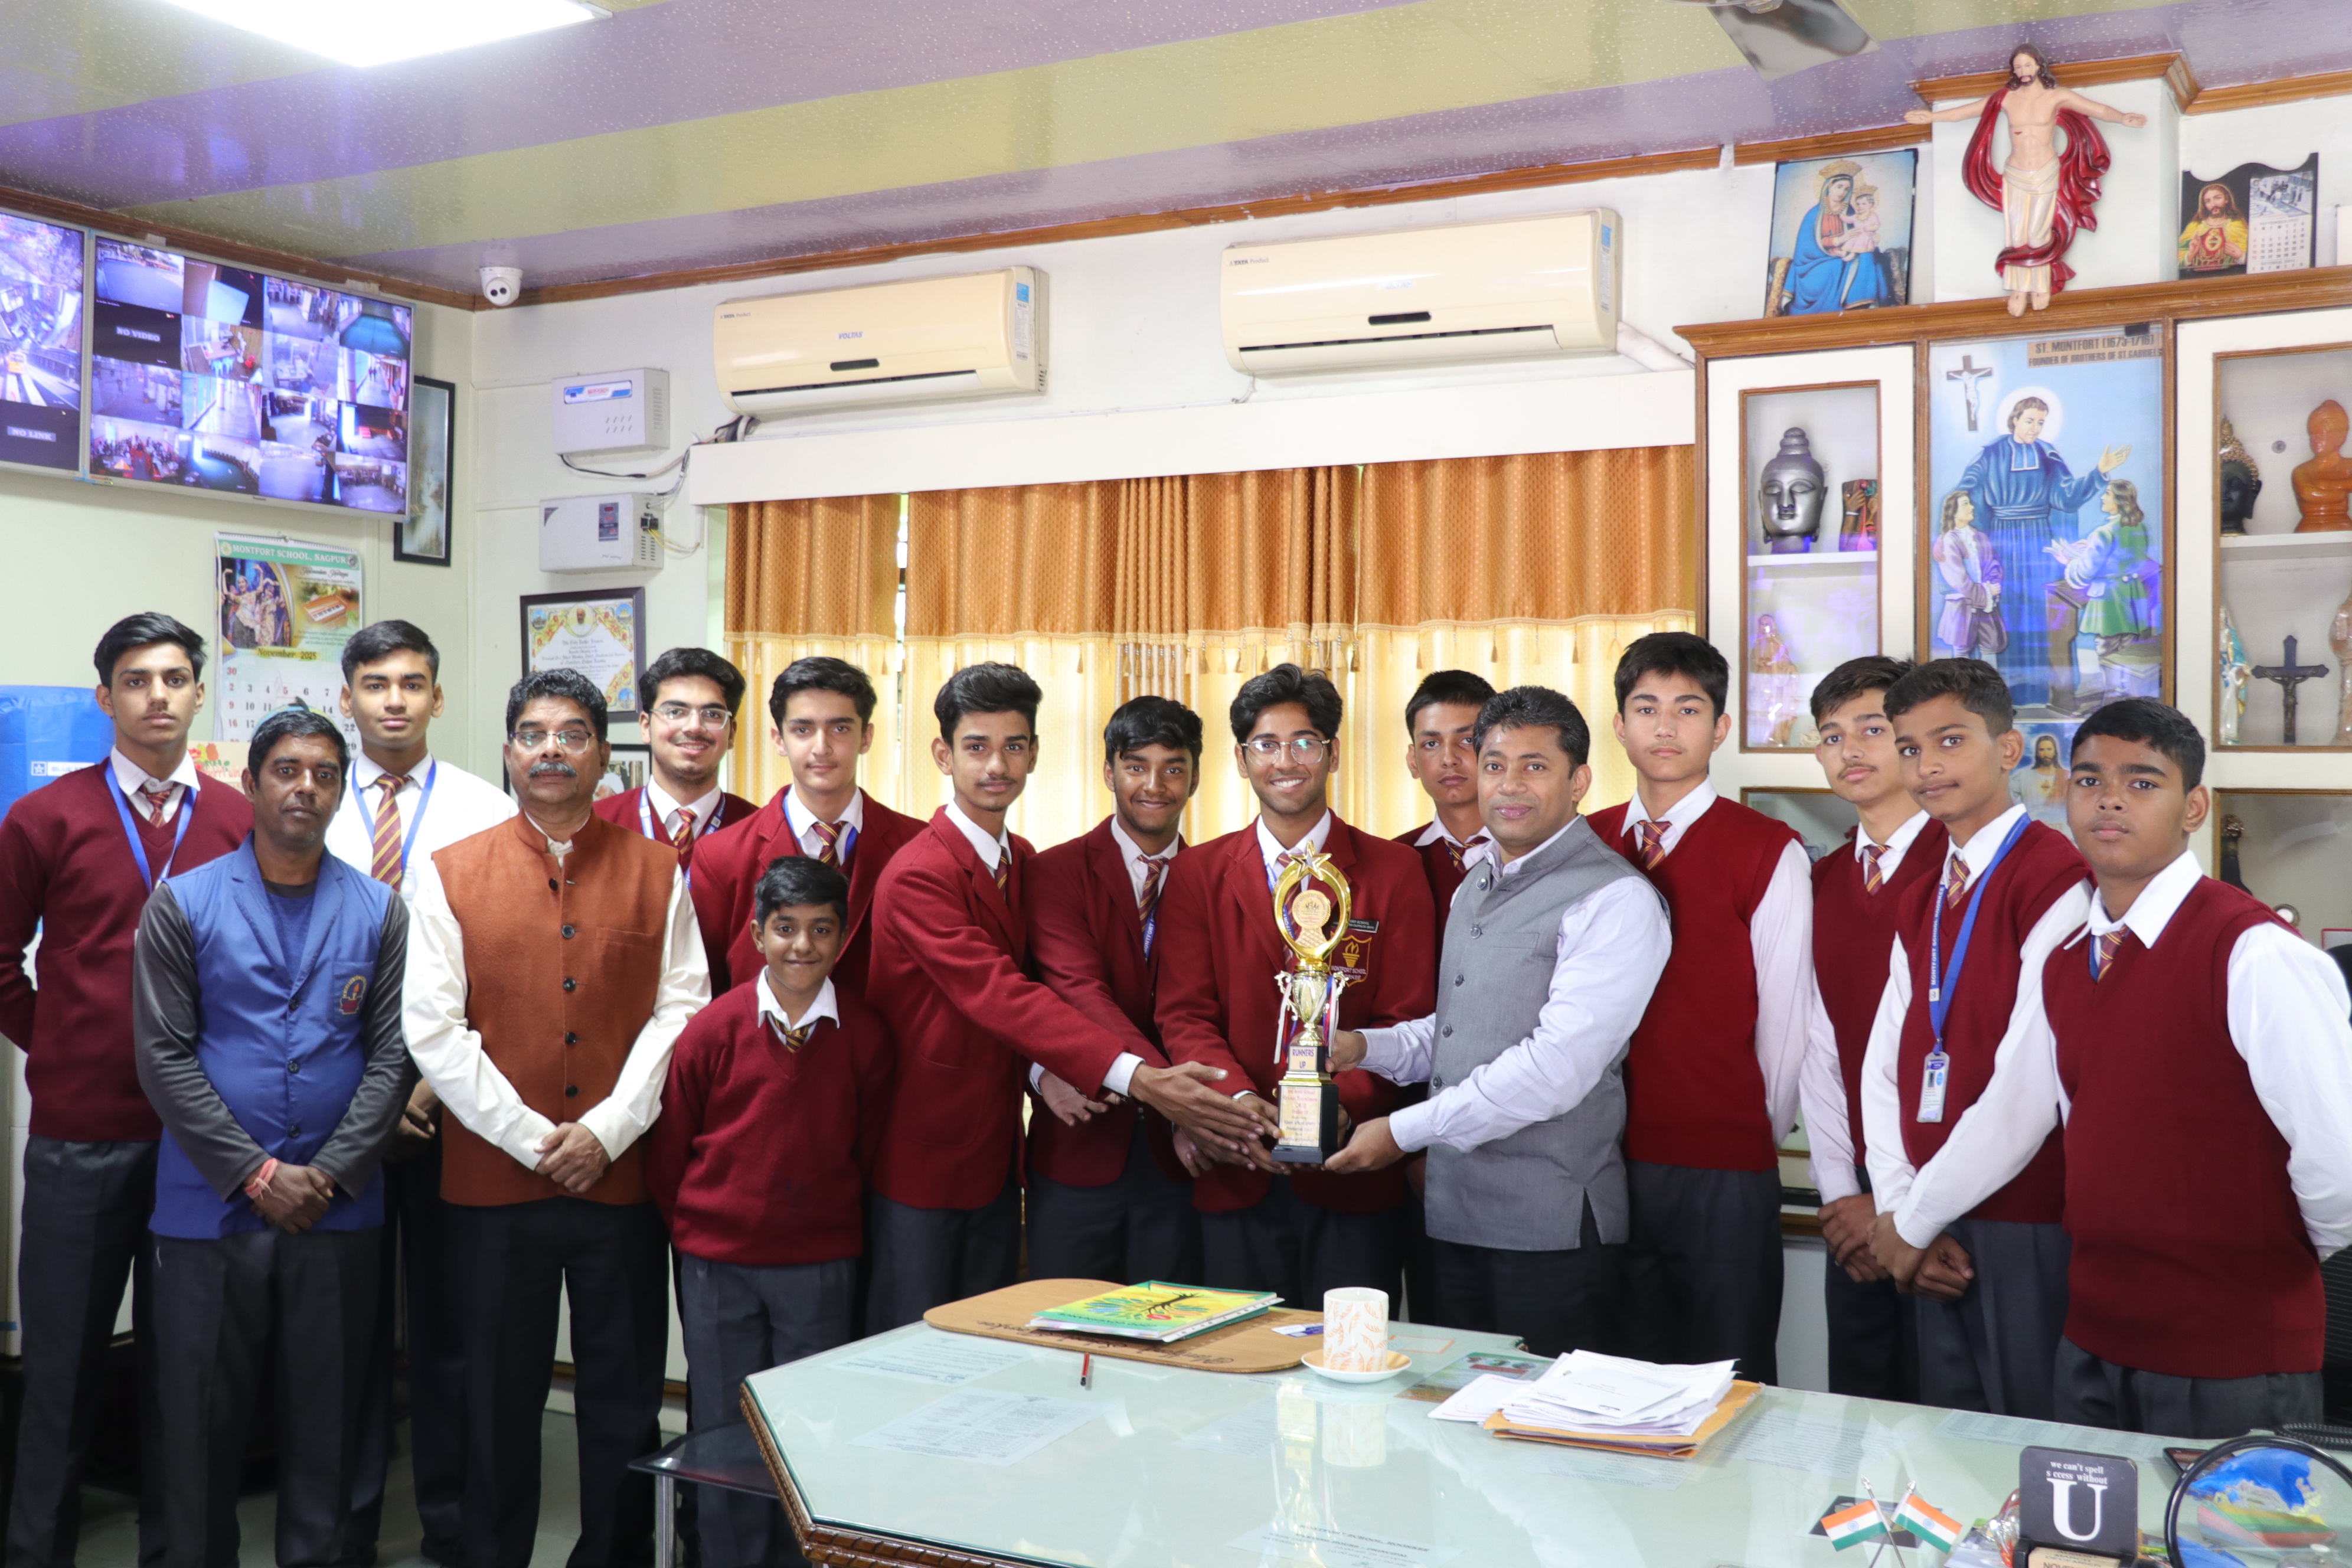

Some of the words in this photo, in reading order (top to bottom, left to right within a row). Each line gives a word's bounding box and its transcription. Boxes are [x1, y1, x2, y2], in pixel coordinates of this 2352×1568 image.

[117, 327, 130, 336] NO
[132, 331, 161, 342] VIDEO
[2035, 343, 2049, 353] ST.
[2052, 339, 2099, 352] MONTFORT
[2028, 356, 2059, 367] FOUNDER
[2071, 353, 2105, 362] BROTHERS
[2108, 351, 2116, 360] OF
[29, 431, 52, 440] LINK
[232, 544, 275, 556] MONTFORT
[277, 550, 312, 561] SCHOOL,
[315, 554, 347, 564] NAGPUR
[257, 648, 295, 658] November
[300, 651, 317, 659] 2025
[227, 667, 237, 675] 30
[230, 683, 234, 691] 2
[248, 684, 252, 692] 3
[265, 685, 270, 694] 4
[283, 687, 288, 695] 5
[229, 701, 234, 709] 9
[246, 702, 254, 711] 10
[263, 703, 271, 711] 11
[323, 705, 332, 714] 14
[228, 718, 238, 727] 16
[246, 720, 254, 729] 17
[1935, 887, 1945, 917] ROORKEE
[1292, 1048, 1314, 1057] RUNNERS
[1299, 1061, 1306, 1069] UP
[2063, 1463, 2083, 1472] can't
[2085, 1466, 2103, 1475] spell
[2053, 1471, 2073, 1480] ccess
[2076, 1474, 2108, 1485] without
[2046, 1477, 2108, 1541] U
